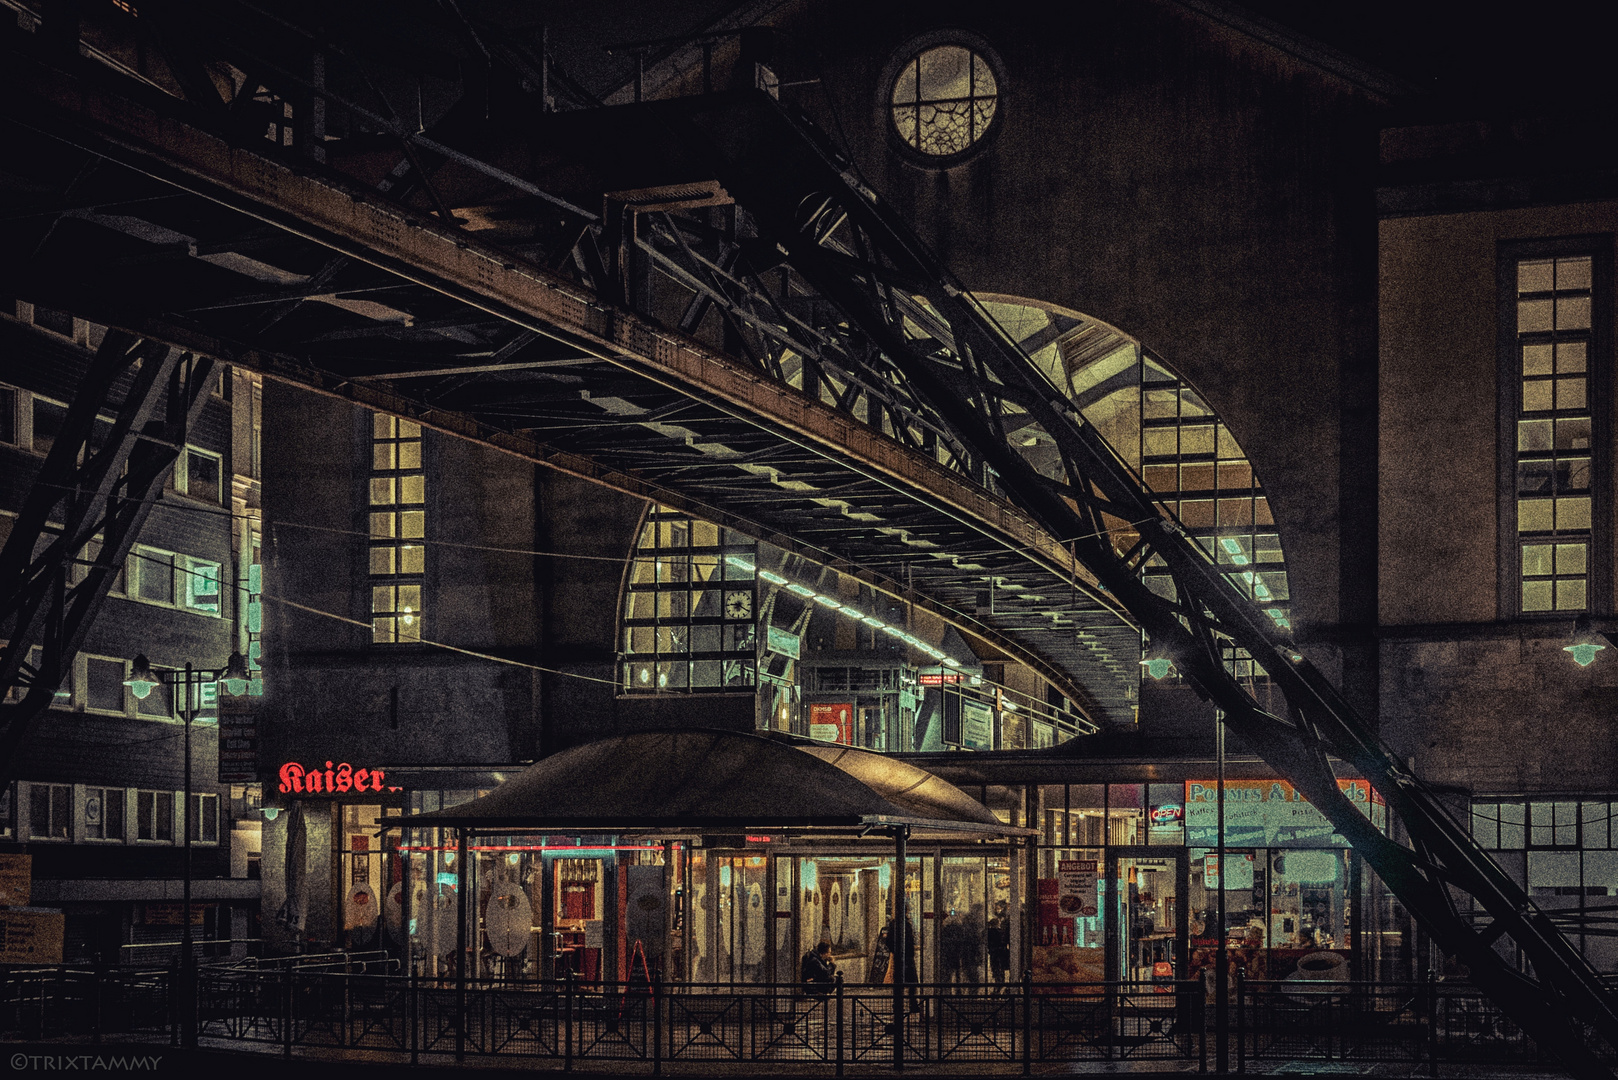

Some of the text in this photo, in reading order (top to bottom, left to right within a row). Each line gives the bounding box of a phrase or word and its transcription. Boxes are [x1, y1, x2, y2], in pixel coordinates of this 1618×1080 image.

[1269, 783, 1285, 801] &
[1151, 807, 1182, 819] OPEN
[1061, 862, 1096, 871] ANGEBOT
